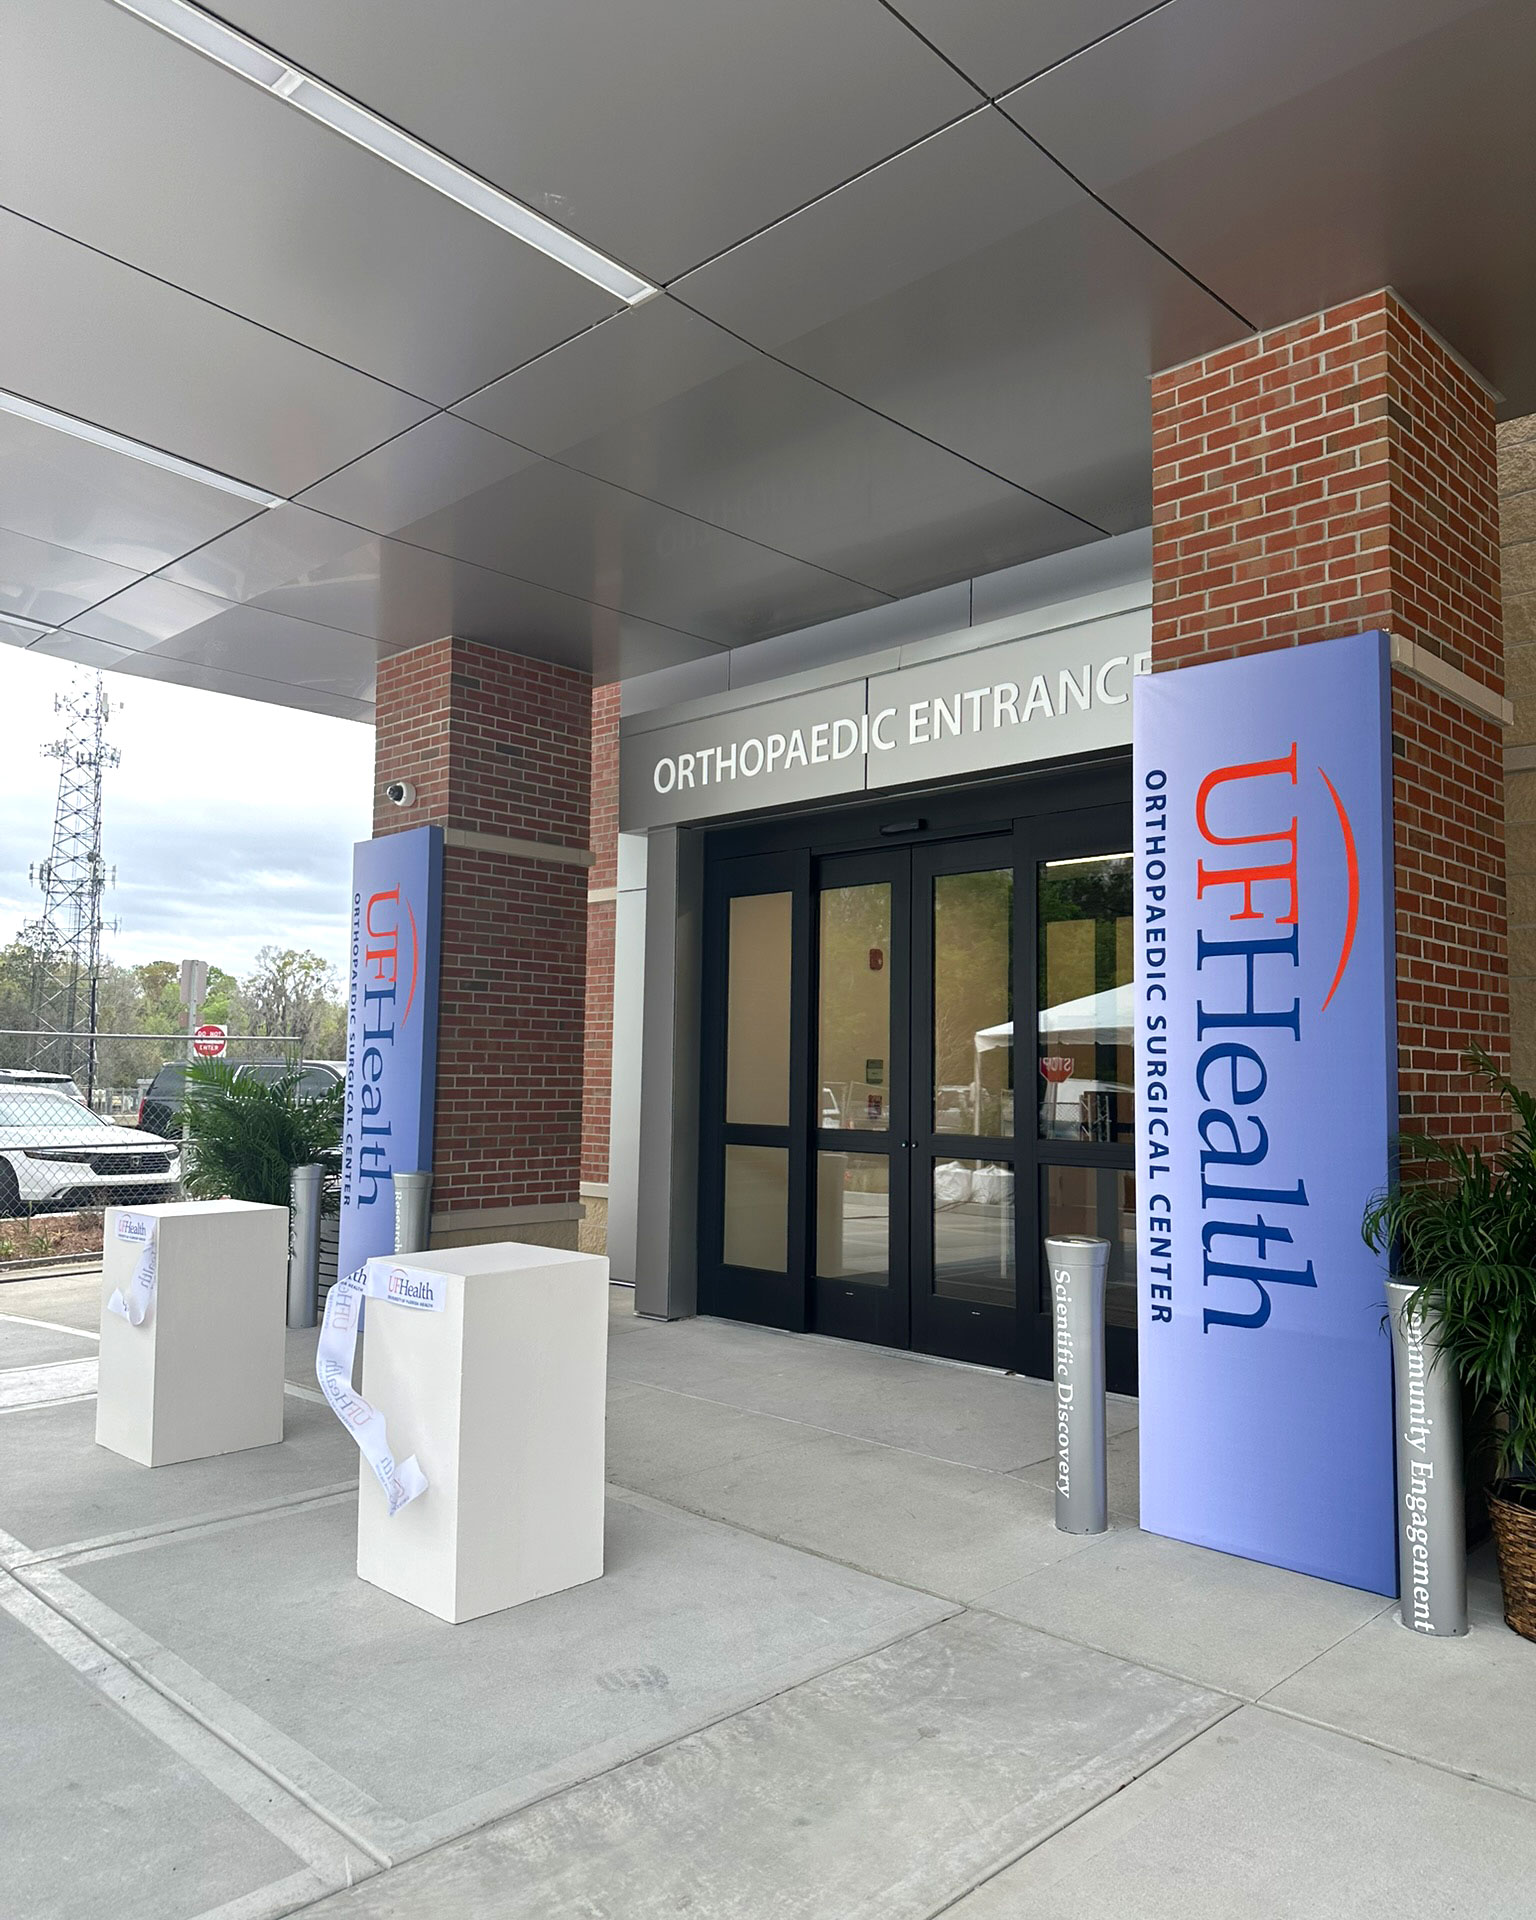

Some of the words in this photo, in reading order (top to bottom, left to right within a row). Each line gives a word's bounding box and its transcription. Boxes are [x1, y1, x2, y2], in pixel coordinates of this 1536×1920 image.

[653, 707, 898, 794] ORTHOPAEDIC
[1145, 769, 1167, 1002] ORTHOPAEDIC
[349, 892, 361, 1025] ORTHOPAEDIC
[345, 1032, 357, 1126] SURGICAL
[1146, 1015, 1169, 1181] SURGICAL
[343, 1133, 354, 1206] CENTER
[394, 1191, 402, 1251] Research
[1149, 1194, 1173, 1324] CENTER
[1053, 1269, 1074, 1377] Scientific
[1054, 1382, 1074, 1499] Discovery
[1405, 1459, 1434, 1632] Engagement
